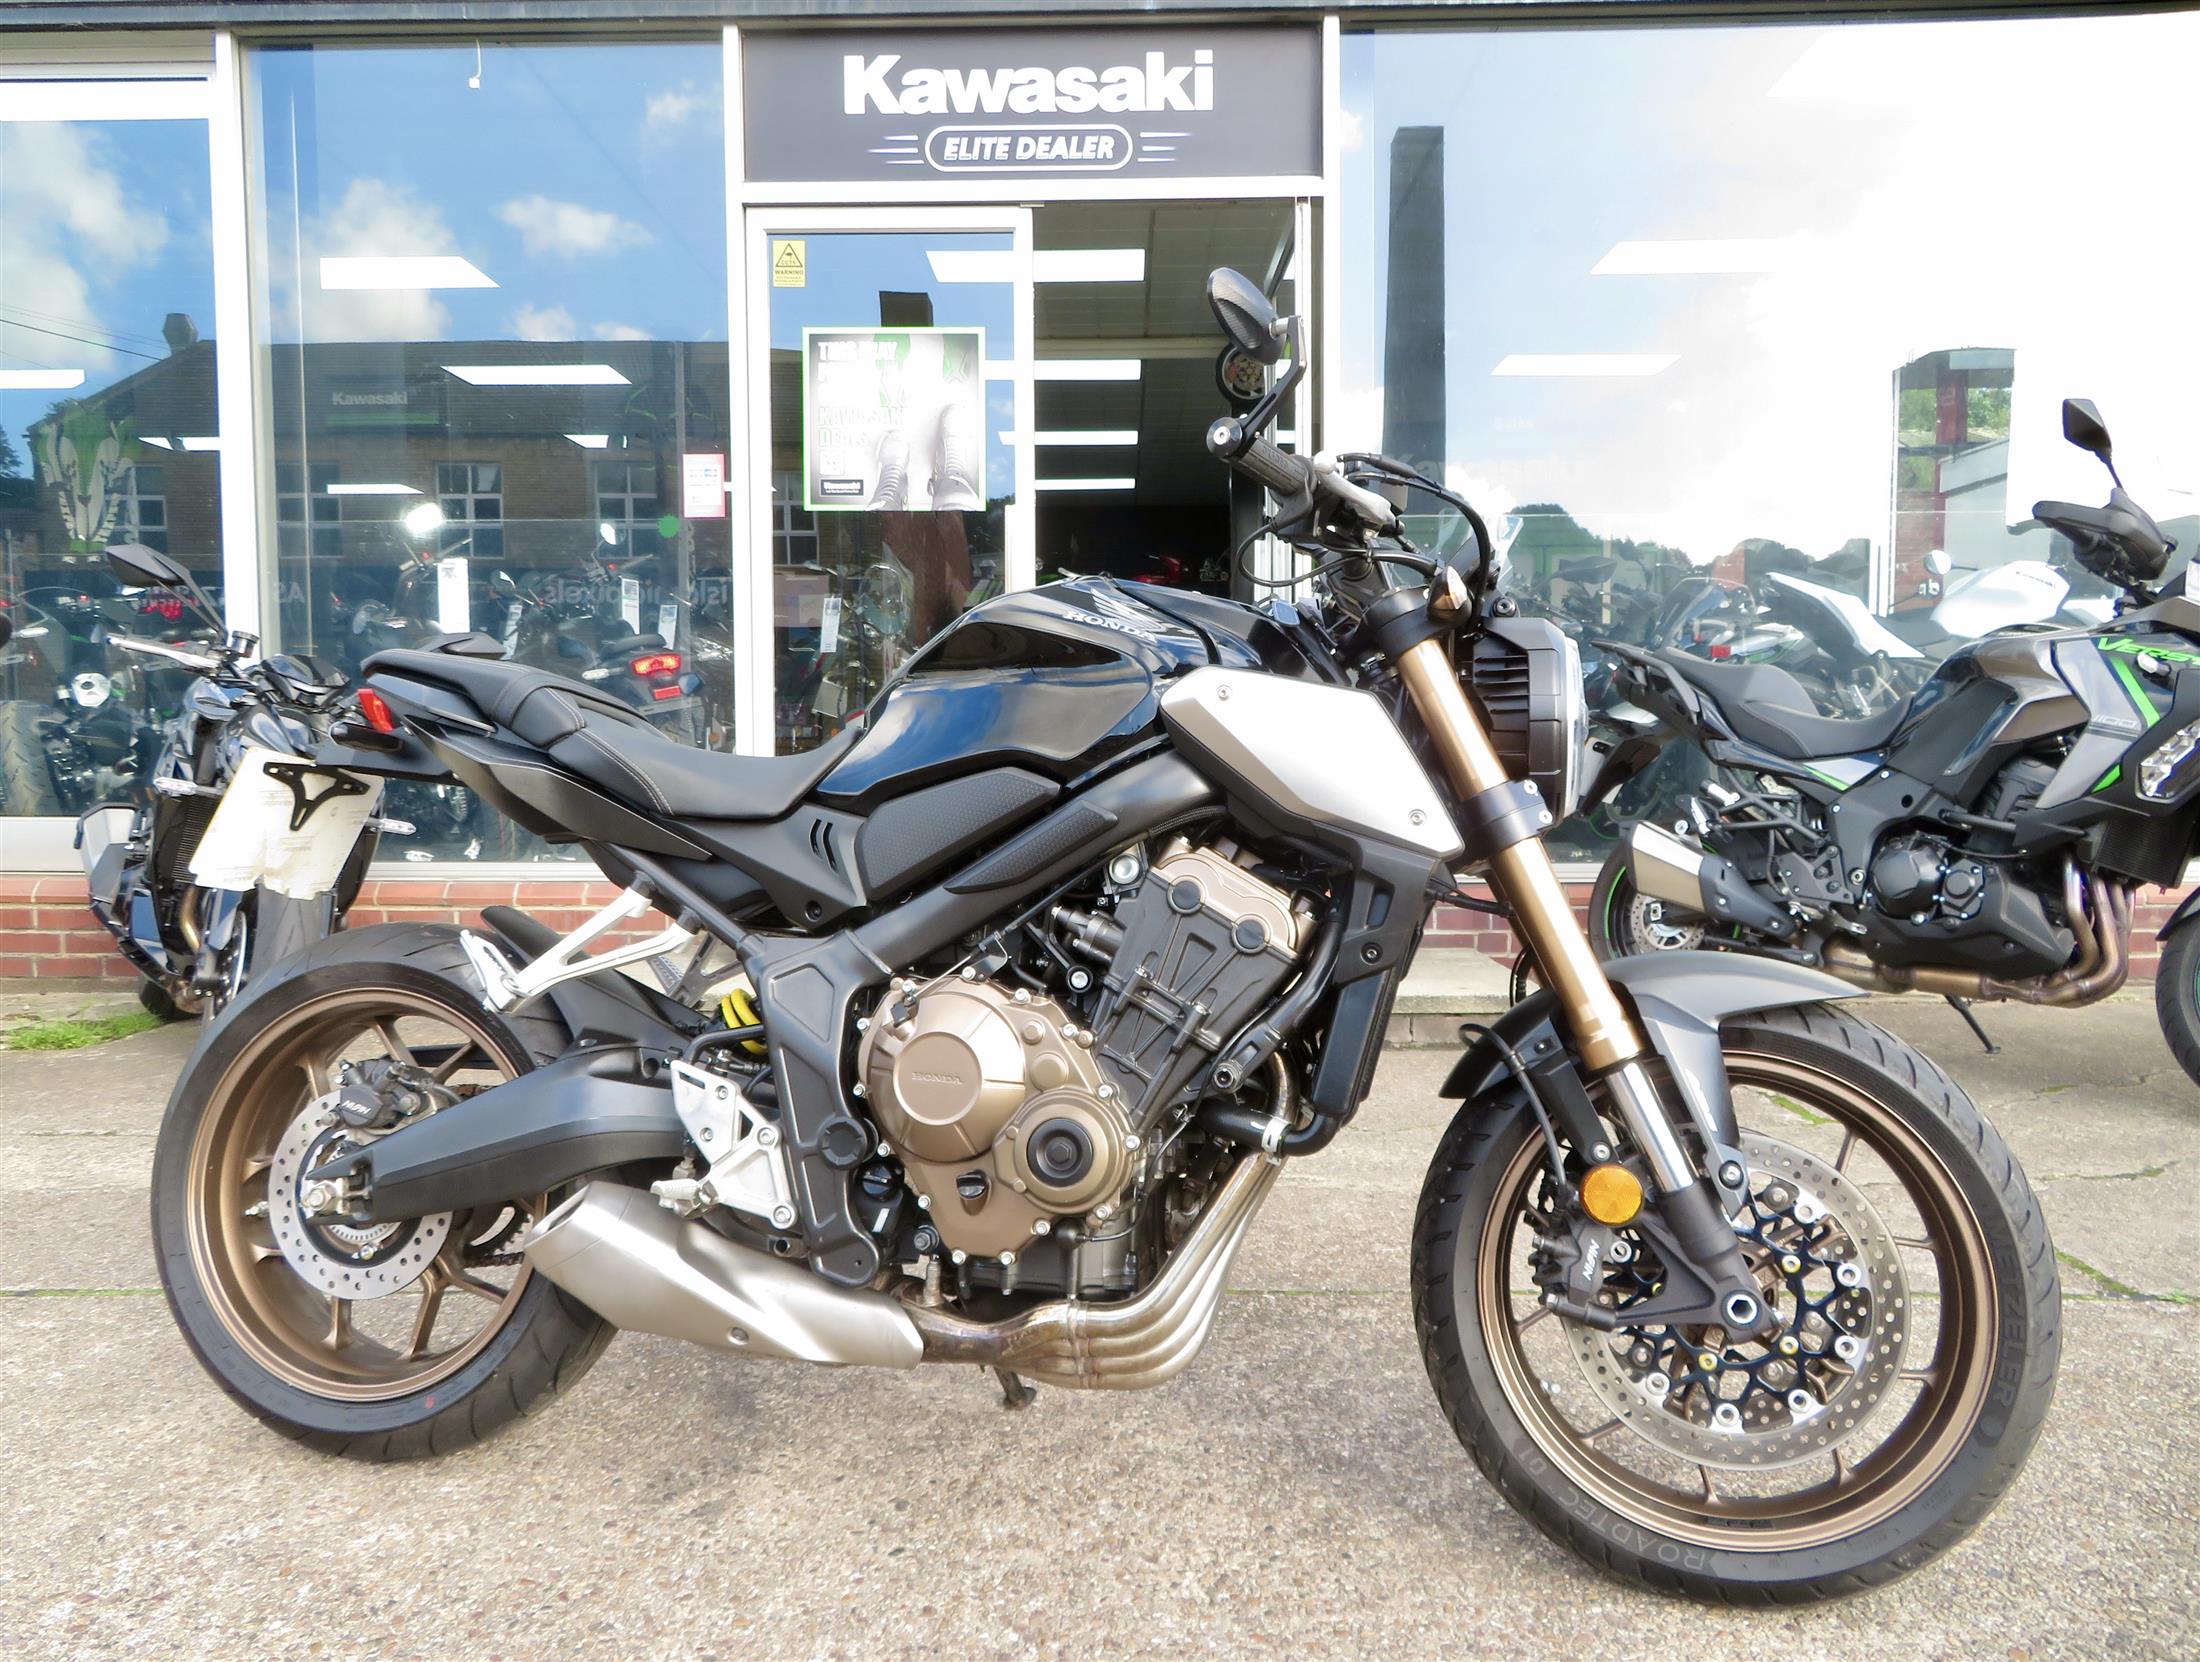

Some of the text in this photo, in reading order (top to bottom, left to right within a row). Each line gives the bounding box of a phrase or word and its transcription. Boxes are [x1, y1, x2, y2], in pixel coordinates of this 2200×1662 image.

[843, 49, 1214, 115] Kawasaki
[943, 135, 1116, 161] ELITE DEALER
[332, 391, 408, 405] Kawasaki
[1062, 610, 1158, 644] HONDA
[911, 1071, 963, 1086] HONDA
[1984, 1206, 2025, 1408] METZELER
[1517, 1446, 1705, 1571] ROADTEC 01
